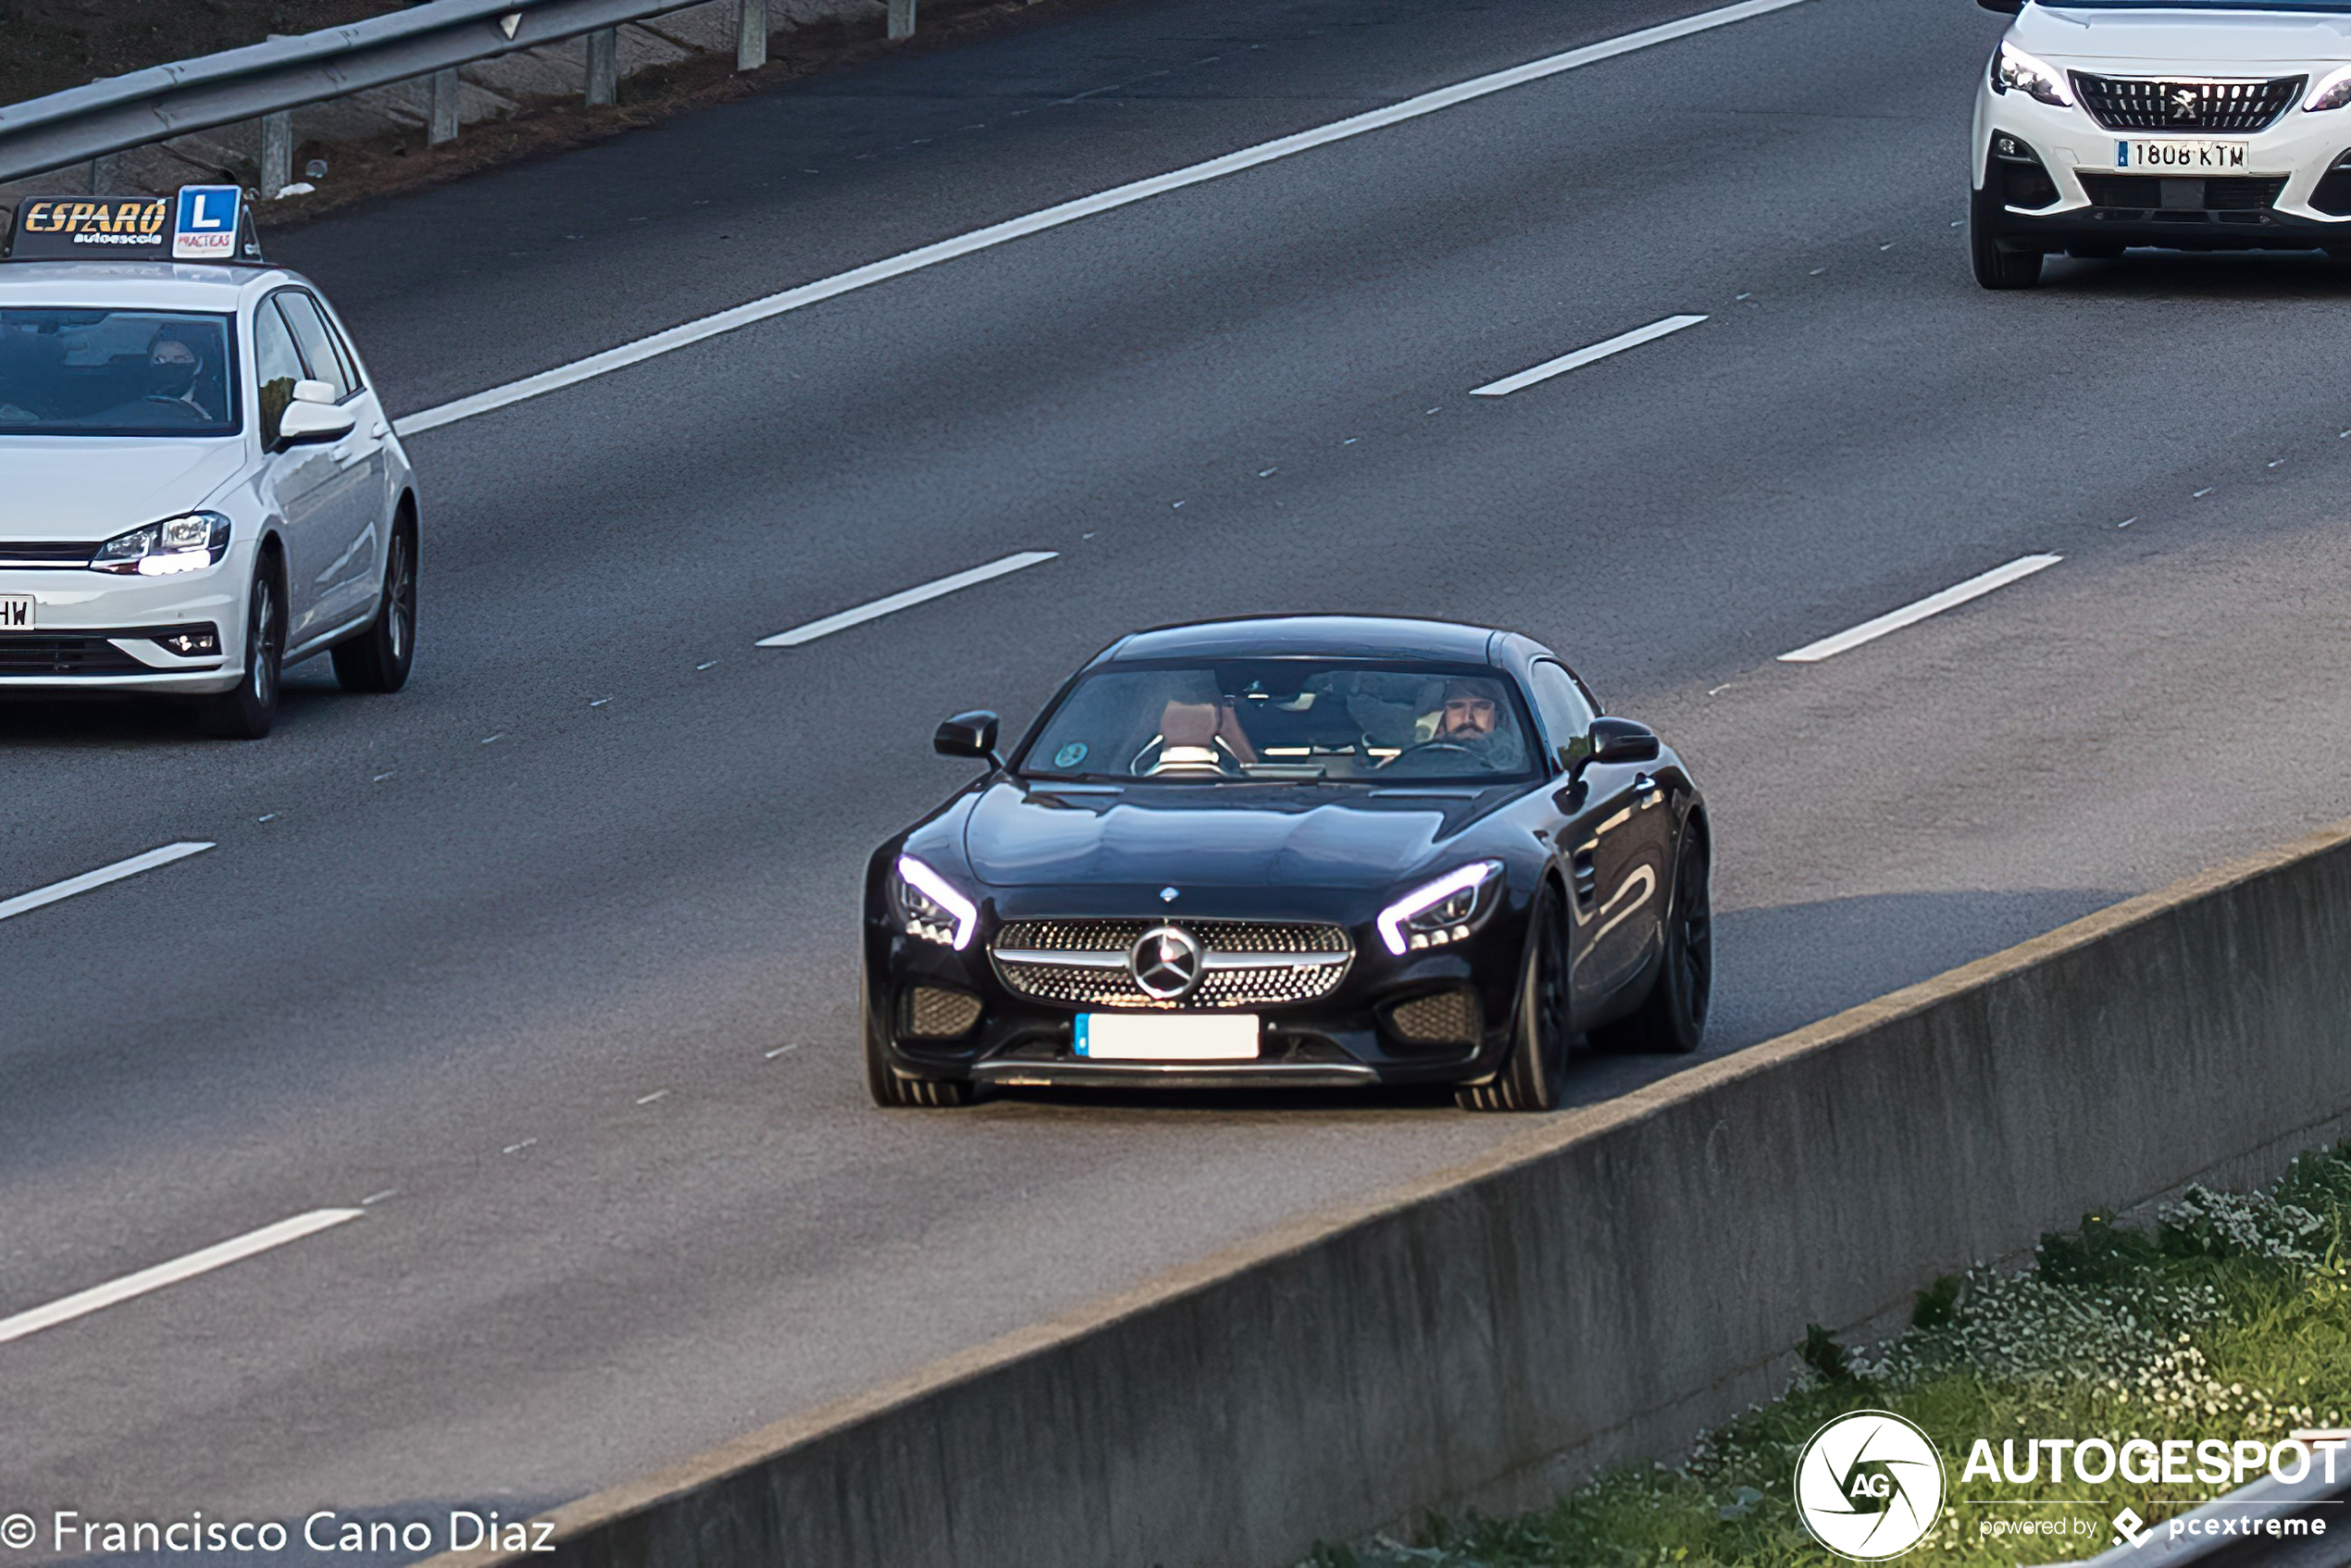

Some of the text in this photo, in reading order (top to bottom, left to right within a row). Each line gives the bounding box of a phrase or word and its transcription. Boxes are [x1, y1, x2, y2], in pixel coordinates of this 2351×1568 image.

[2136, 144, 2244, 168] 1808 KTM
[192, 194, 220, 228] L
[73, 232, 162, 244] autoescola
